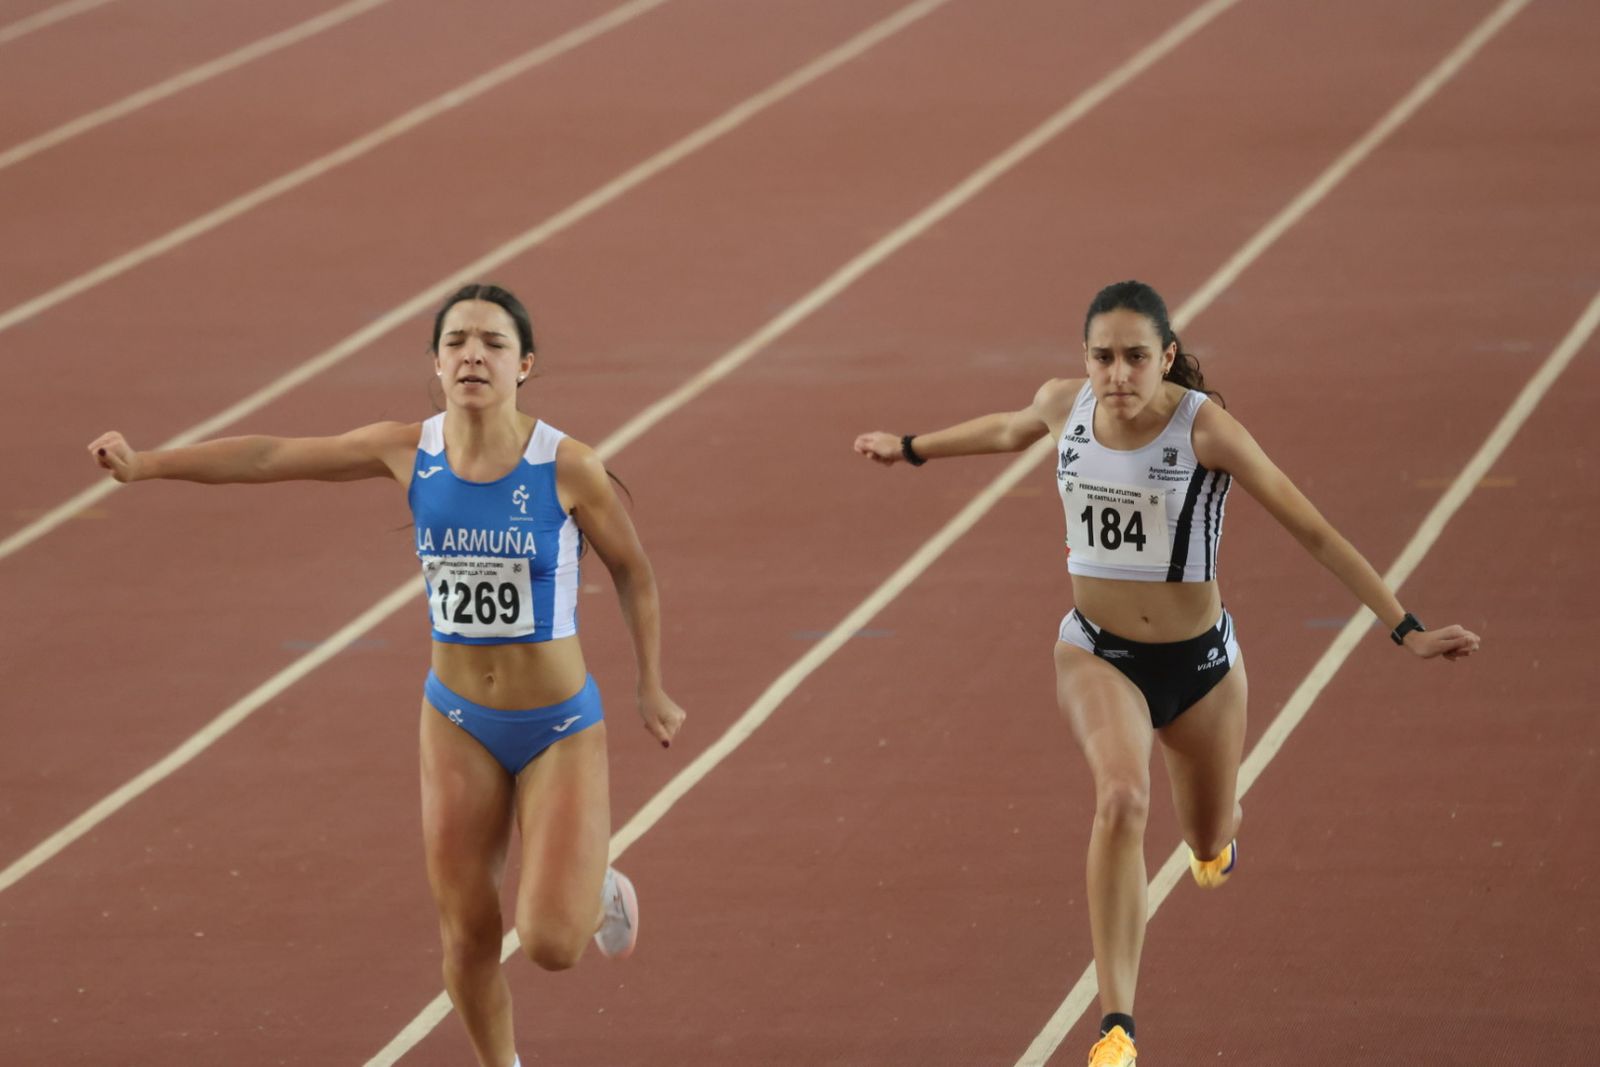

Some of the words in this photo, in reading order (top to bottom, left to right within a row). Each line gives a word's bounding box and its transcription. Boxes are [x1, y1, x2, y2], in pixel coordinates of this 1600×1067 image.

[1065, 435, 1090, 444] VIATOR
[1149, 466, 1190, 476] Ayuntamiento
[1079, 483, 1108, 493] FEDERACIÓN
[1115, 489, 1142, 498] ATLETISMO
[1094, 495, 1117, 503] CASTILLA
[1081, 505, 1147, 552] 184
[417, 527, 436, 552] LA
[442, 526, 537, 555] ARMUÑA
[438, 579, 520, 625] 1269
[1197, 655, 1226, 671] VIATOR
